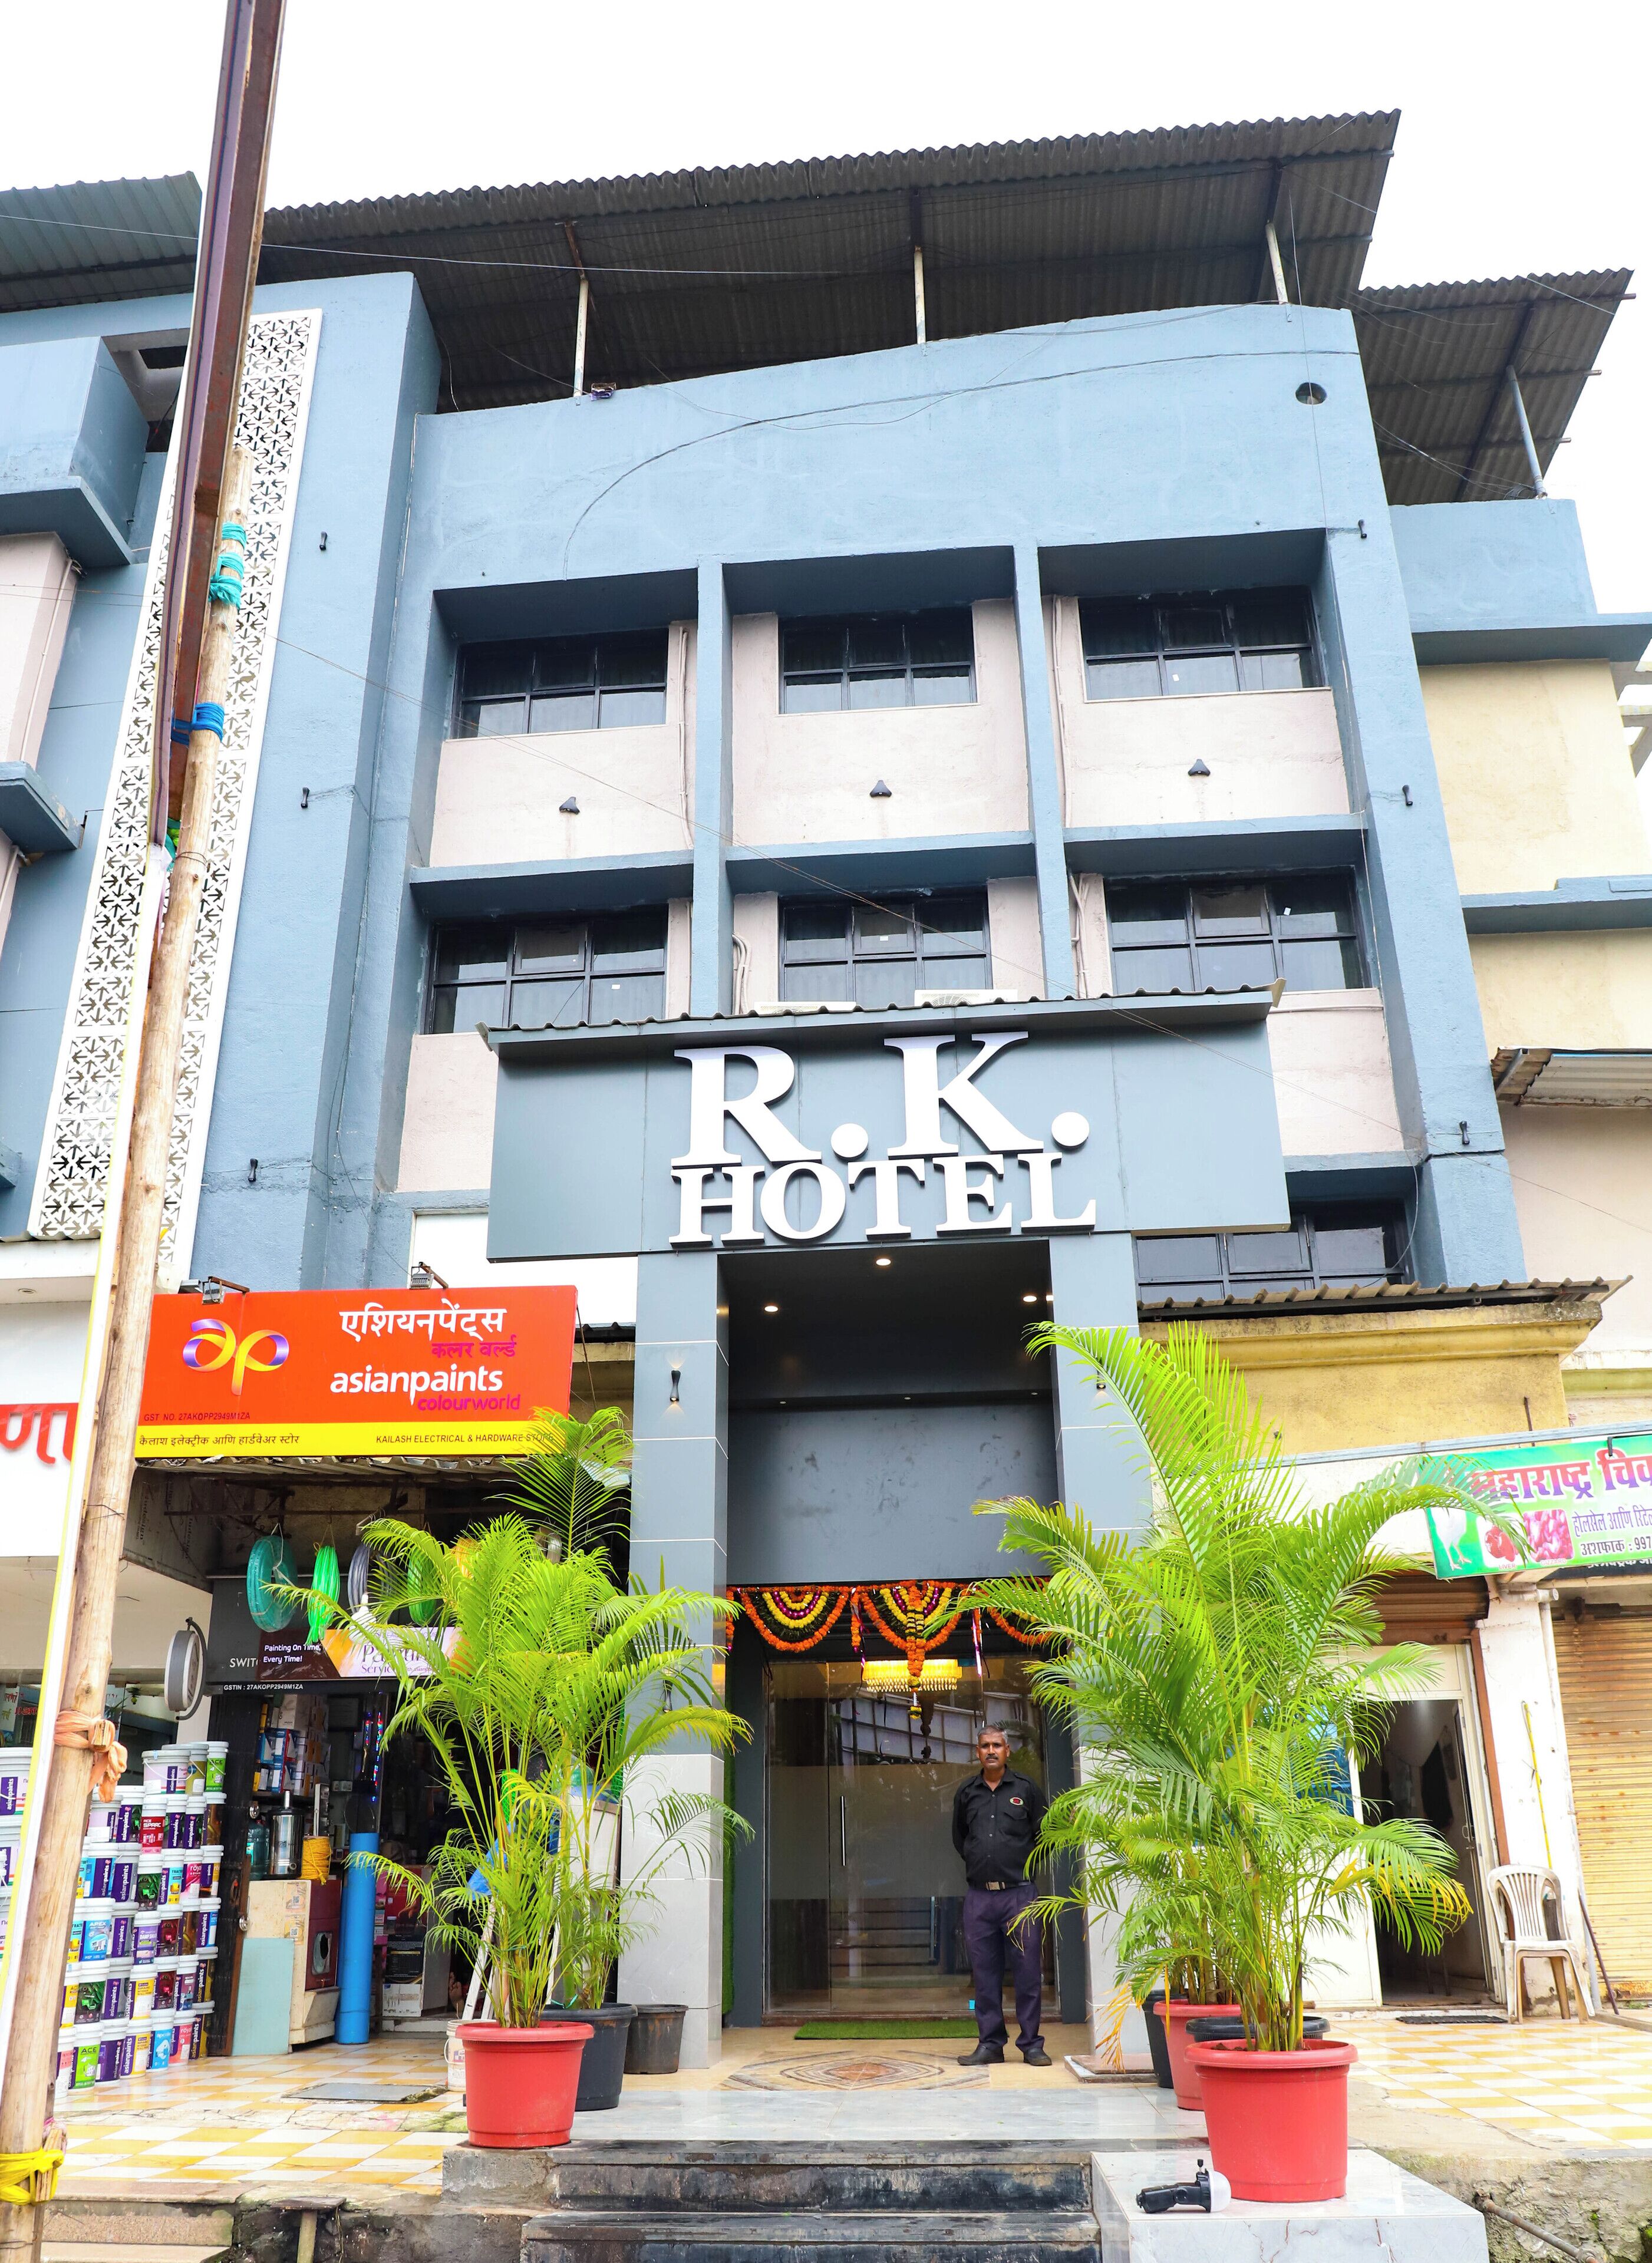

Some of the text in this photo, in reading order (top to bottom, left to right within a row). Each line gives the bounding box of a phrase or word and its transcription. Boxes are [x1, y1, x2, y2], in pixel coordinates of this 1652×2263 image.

[668, 1152, 1097, 1248] HOTEL
[338, 1298, 508, 1342] एशियनपेंट्स
[431, 1334, 517, 1358] कलर वर्ल्ड
[329, 1363, 503, 1406] asianpaints
[417, 1394, 521, 1411] colourworld
[139, 1434, 167, 1446] कैलाश
[212, 1434, 235, 1445] आणि
[239, 1433, 276, 1444] हार्डवेअर
[279, 1433, 299, 1444] स्टोर
[376, 1434, 412, 1443] KAILASH
[414, 1434, 465, 1443] ELECTRICAL
[467, 1434, 473, 1443] &
[476, 1434, 523, 1442] HARDWARE
[1571, 1509, 1607, 1537] होलसेल
[1607, 1506, 1634, 1530] आणि
[263, 1656, 282, 1664] Every
[264, 1644, 291, 1653] Painting
[101, 1864, 110, 1897] asianpaints
[121, 1865, 130, 1900] asianpaints
